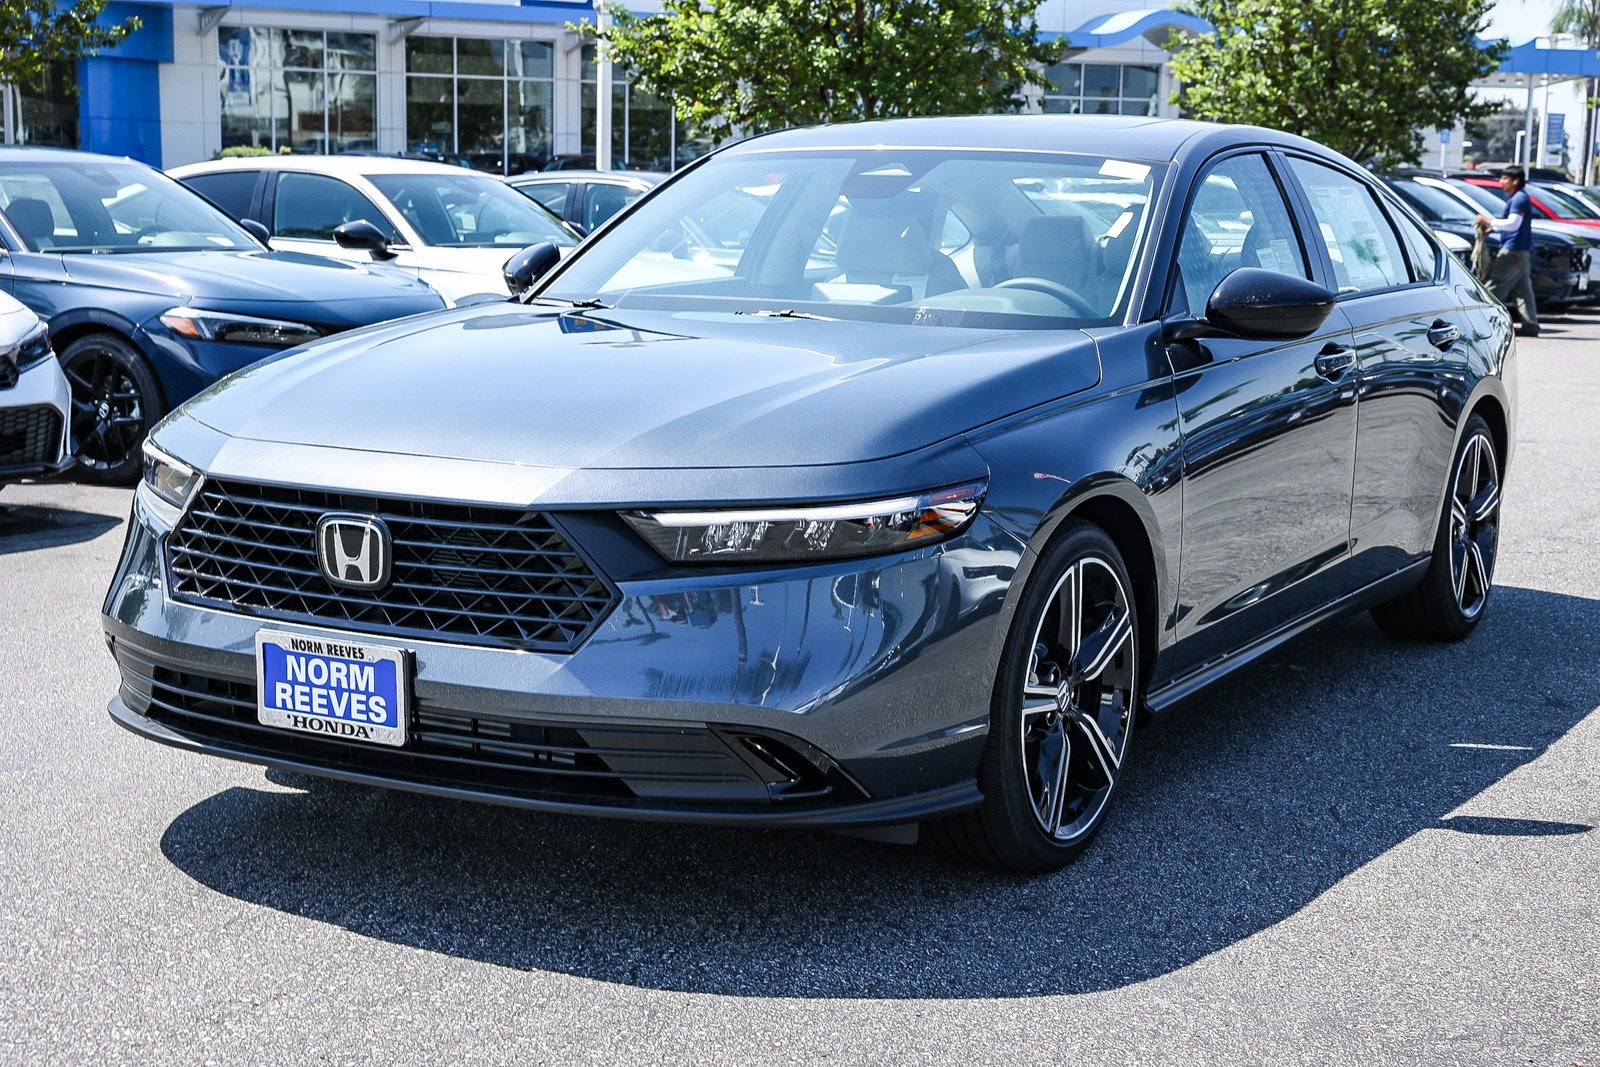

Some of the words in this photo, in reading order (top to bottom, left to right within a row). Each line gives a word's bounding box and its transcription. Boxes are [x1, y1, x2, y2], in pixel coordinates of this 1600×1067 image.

[291, 638, 323, 654] NORM
[326, 642, 365, 660] REEVES
[286, 654, 375, 693] NORM
[275, 681, 388, 724] REEVES
[292, 713, 371, 739] HONDA
